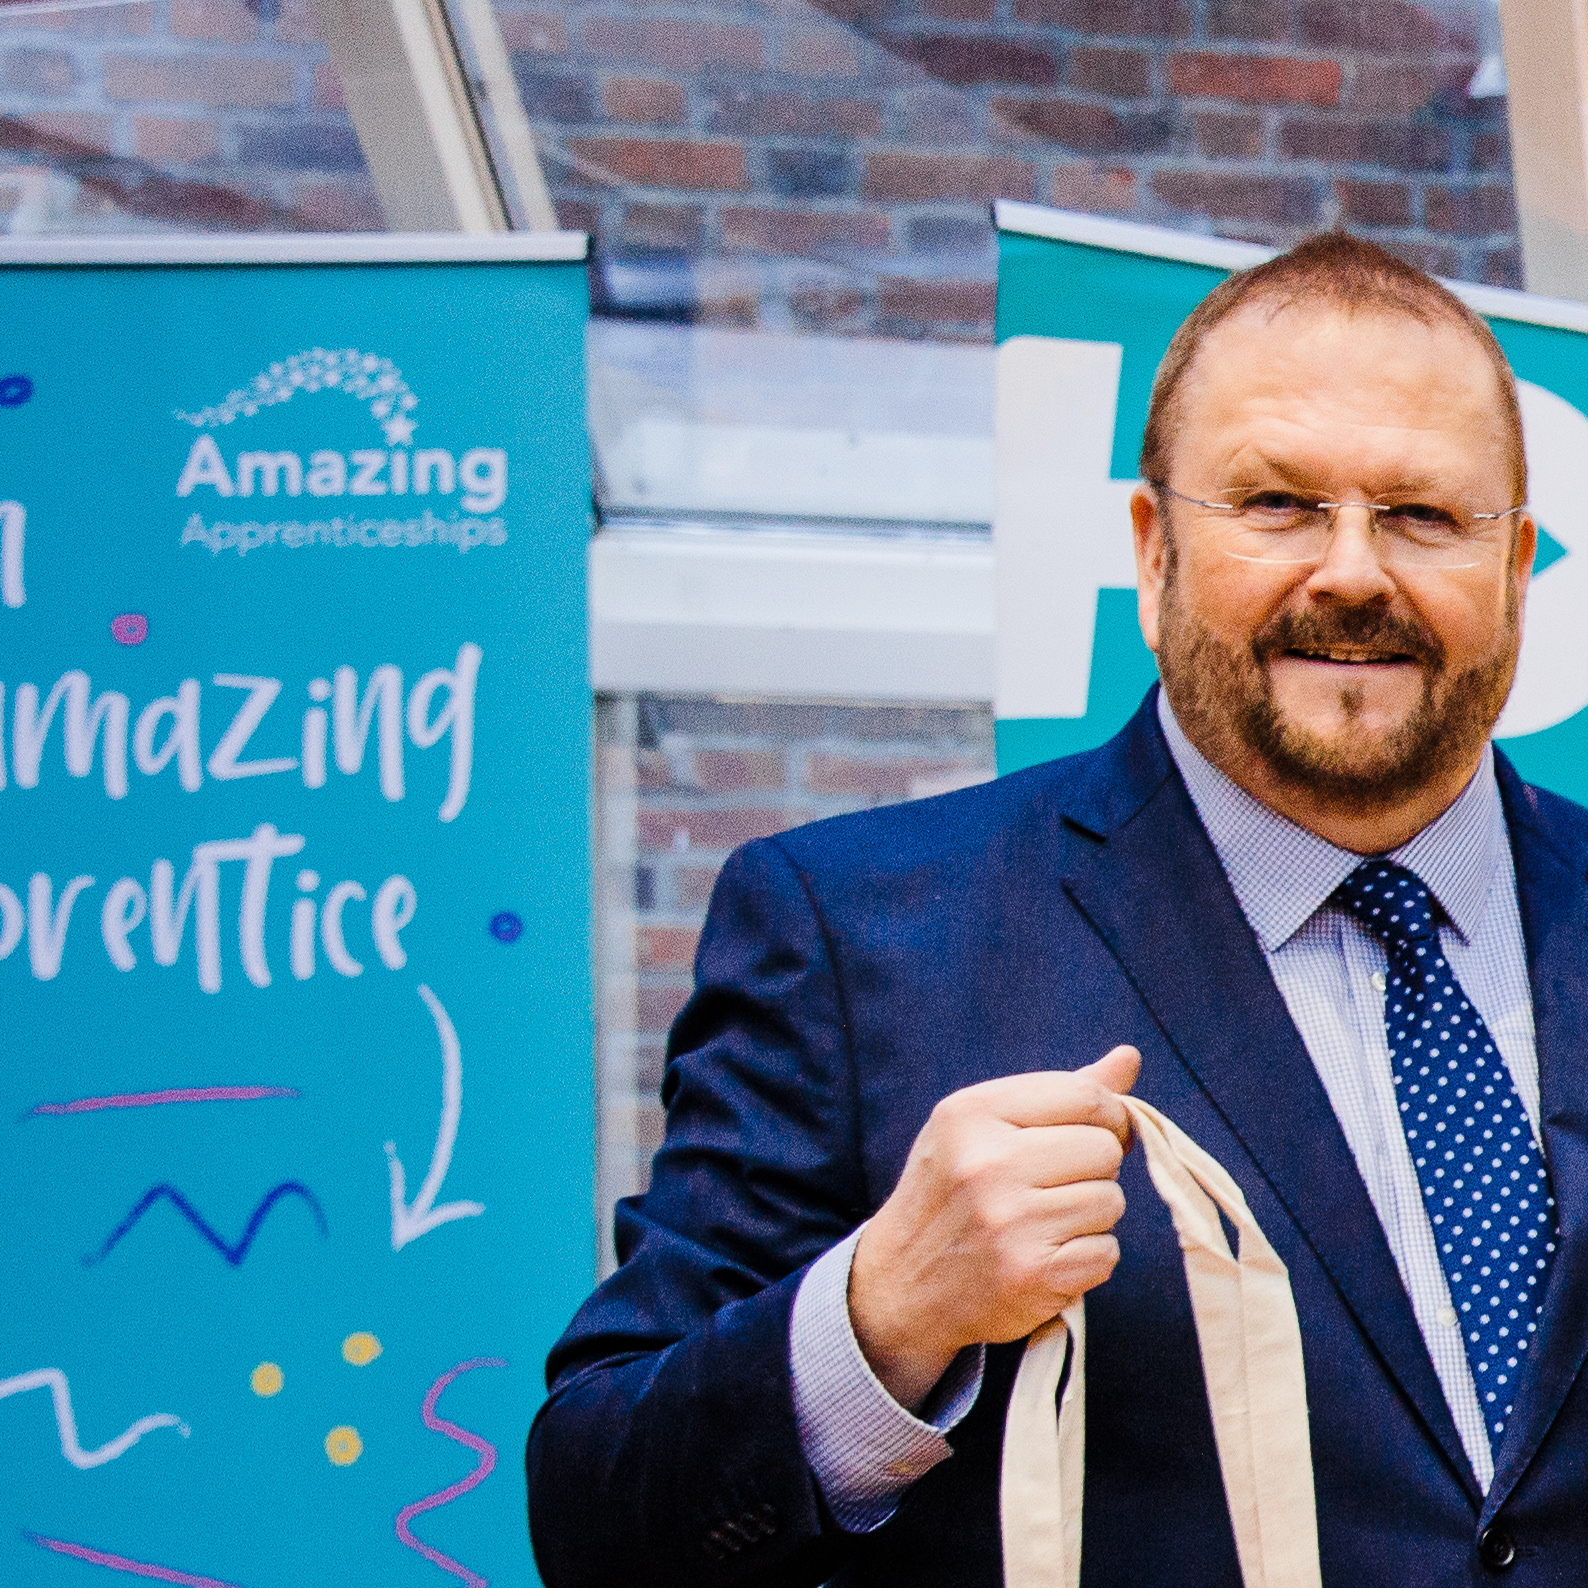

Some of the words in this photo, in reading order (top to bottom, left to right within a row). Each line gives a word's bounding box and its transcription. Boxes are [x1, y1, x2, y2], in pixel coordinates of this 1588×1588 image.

[175, 433, 508, 514] Amazing
[180, 512, 508, 557] Apprenticeships
[0, 641, 482, 823] mazing
